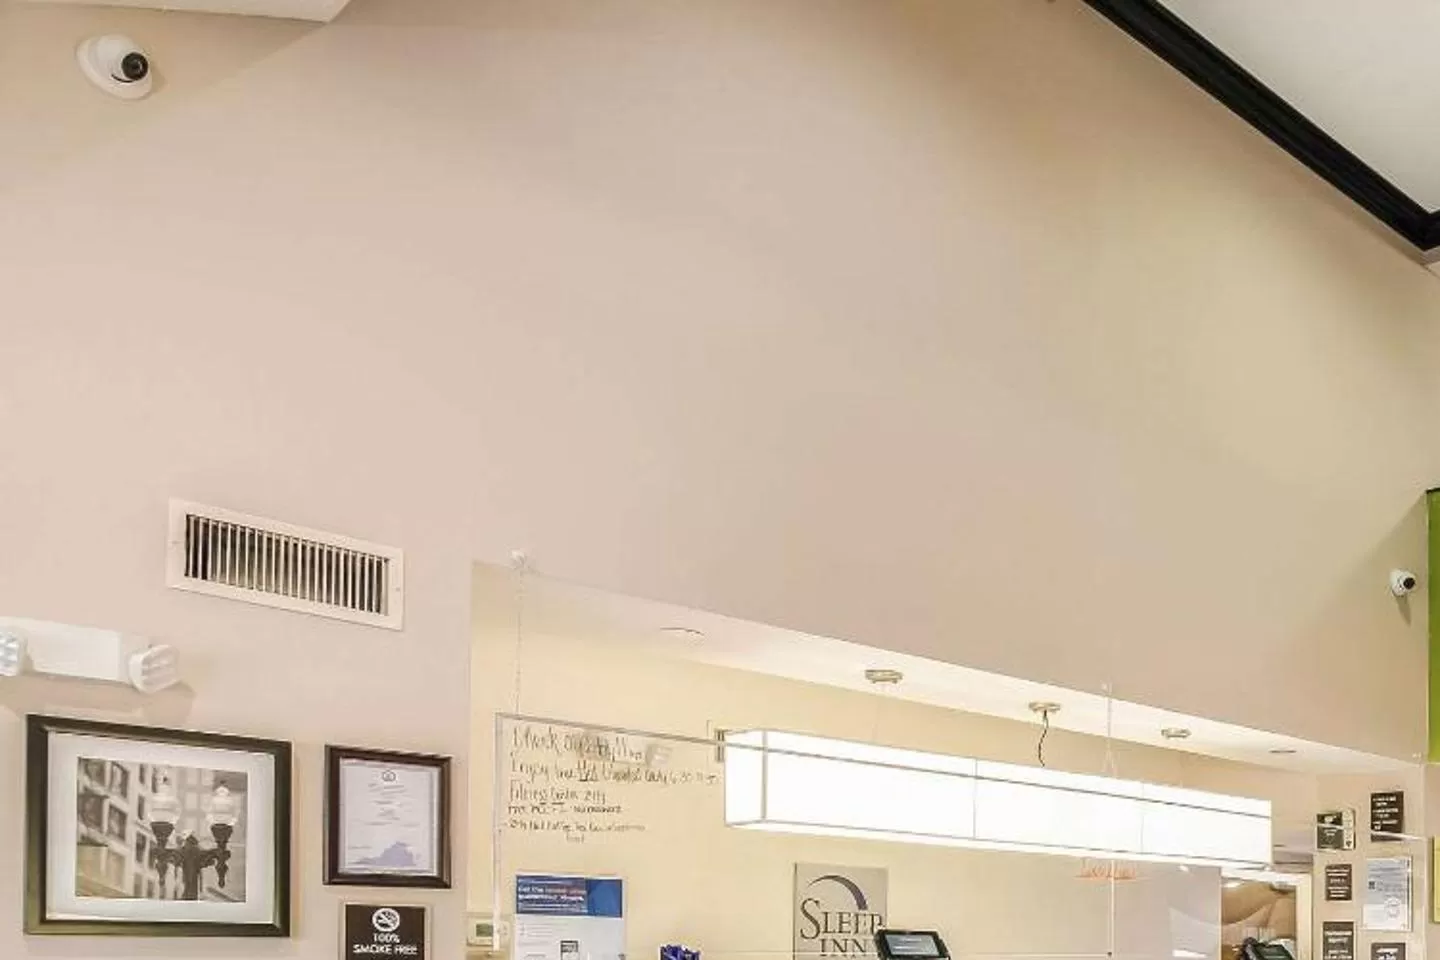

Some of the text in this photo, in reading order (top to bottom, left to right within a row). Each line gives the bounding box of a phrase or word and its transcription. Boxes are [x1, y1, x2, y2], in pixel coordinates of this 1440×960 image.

[800, 898, 885, 940] SLEEP
[373, 932, 401, 943] 100%
[352, 943, 418, 955] SMOKE FREE
[819, 938, 868, 957] INN
